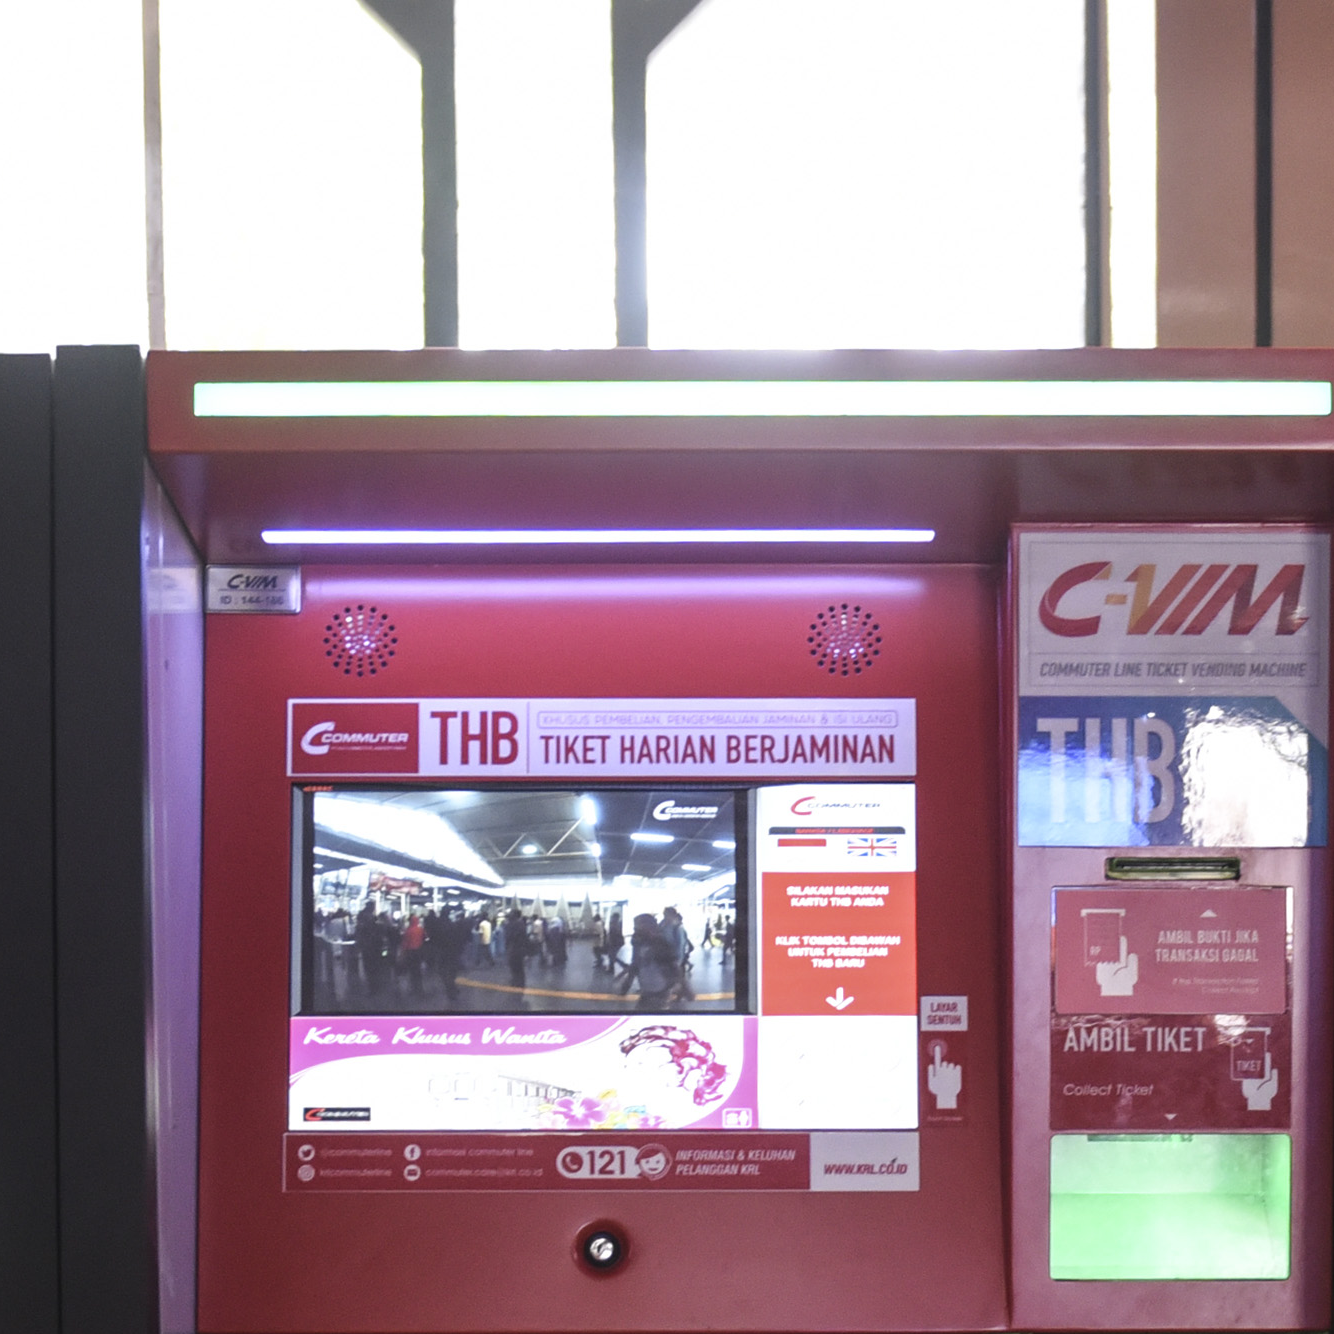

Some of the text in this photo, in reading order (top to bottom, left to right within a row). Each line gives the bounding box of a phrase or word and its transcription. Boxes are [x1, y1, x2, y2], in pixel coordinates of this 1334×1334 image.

[1039, 561, 1310, 637] C-VIM
[1040, 662, 1307, 678] COMMUTER LINE TICKET VENDING MACHINE
[430, 711, 519, 766] THB
[540, 735, 895, 764] TIKET HARIAN BERJAMINAN
[1037, 718, 1176, 824] THB
[1158, 930, 1231, 944] AMBIL BUKTI
[1155, 949, 1220, 962] TRANSAKSI
[303, 1027, 567, 1045] Kereta Khusus Wanita
[1063, 1027, 1207, 1052] AMBIL TIKET
[1236, 1060, 1261, 1072] TIKET
[1063, 1083, 1154, 1095] Collect Ticket
[587, 1150, 626, 1177] 121
[675, 1149, 797, 1162] INFORMASI & KELUHAN
[675, 1163, 761, 1176] PELANGGAN KRL
[823, 1162, 908, 1176] WWW.KRL.CO.ID
